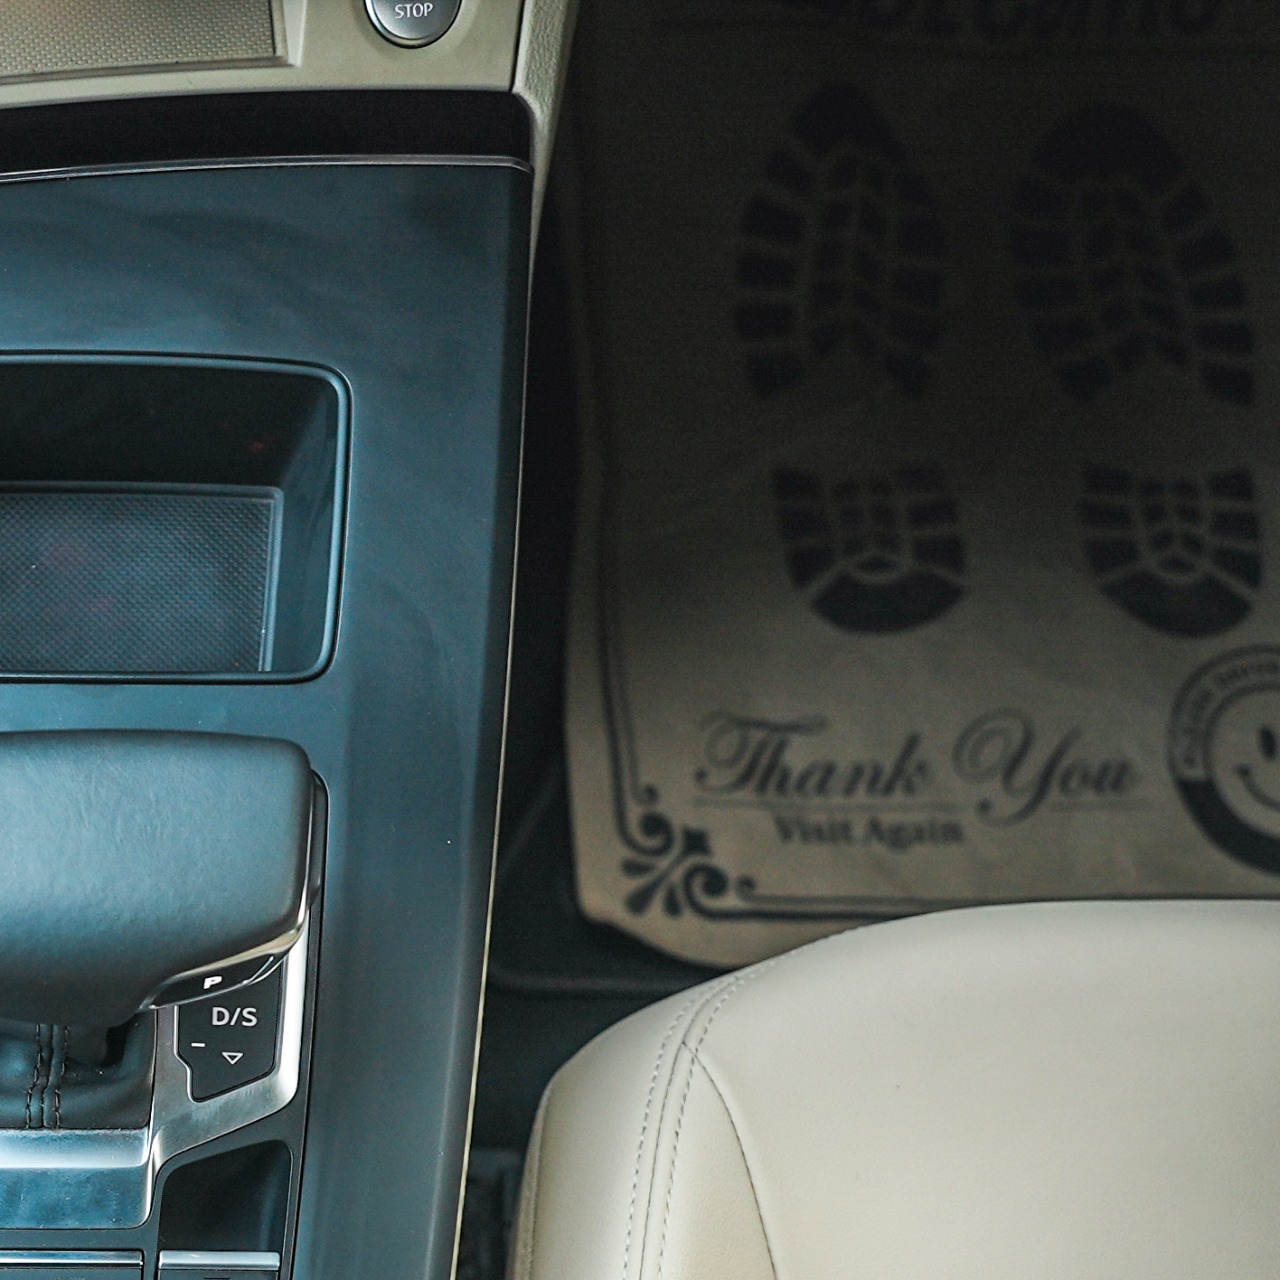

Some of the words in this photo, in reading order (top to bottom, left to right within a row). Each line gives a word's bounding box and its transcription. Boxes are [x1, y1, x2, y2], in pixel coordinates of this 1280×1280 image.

[394, 2, 434, 20] STOP
[694, 711, 928, 797] Thank
[951, 707, 1138, 828] You
[773, 815, 853, 844] Visit
[863, 815, 966, 853] Again
[203, 976, 222, 989] P
[211, 1006, 258, 1027] D/S
